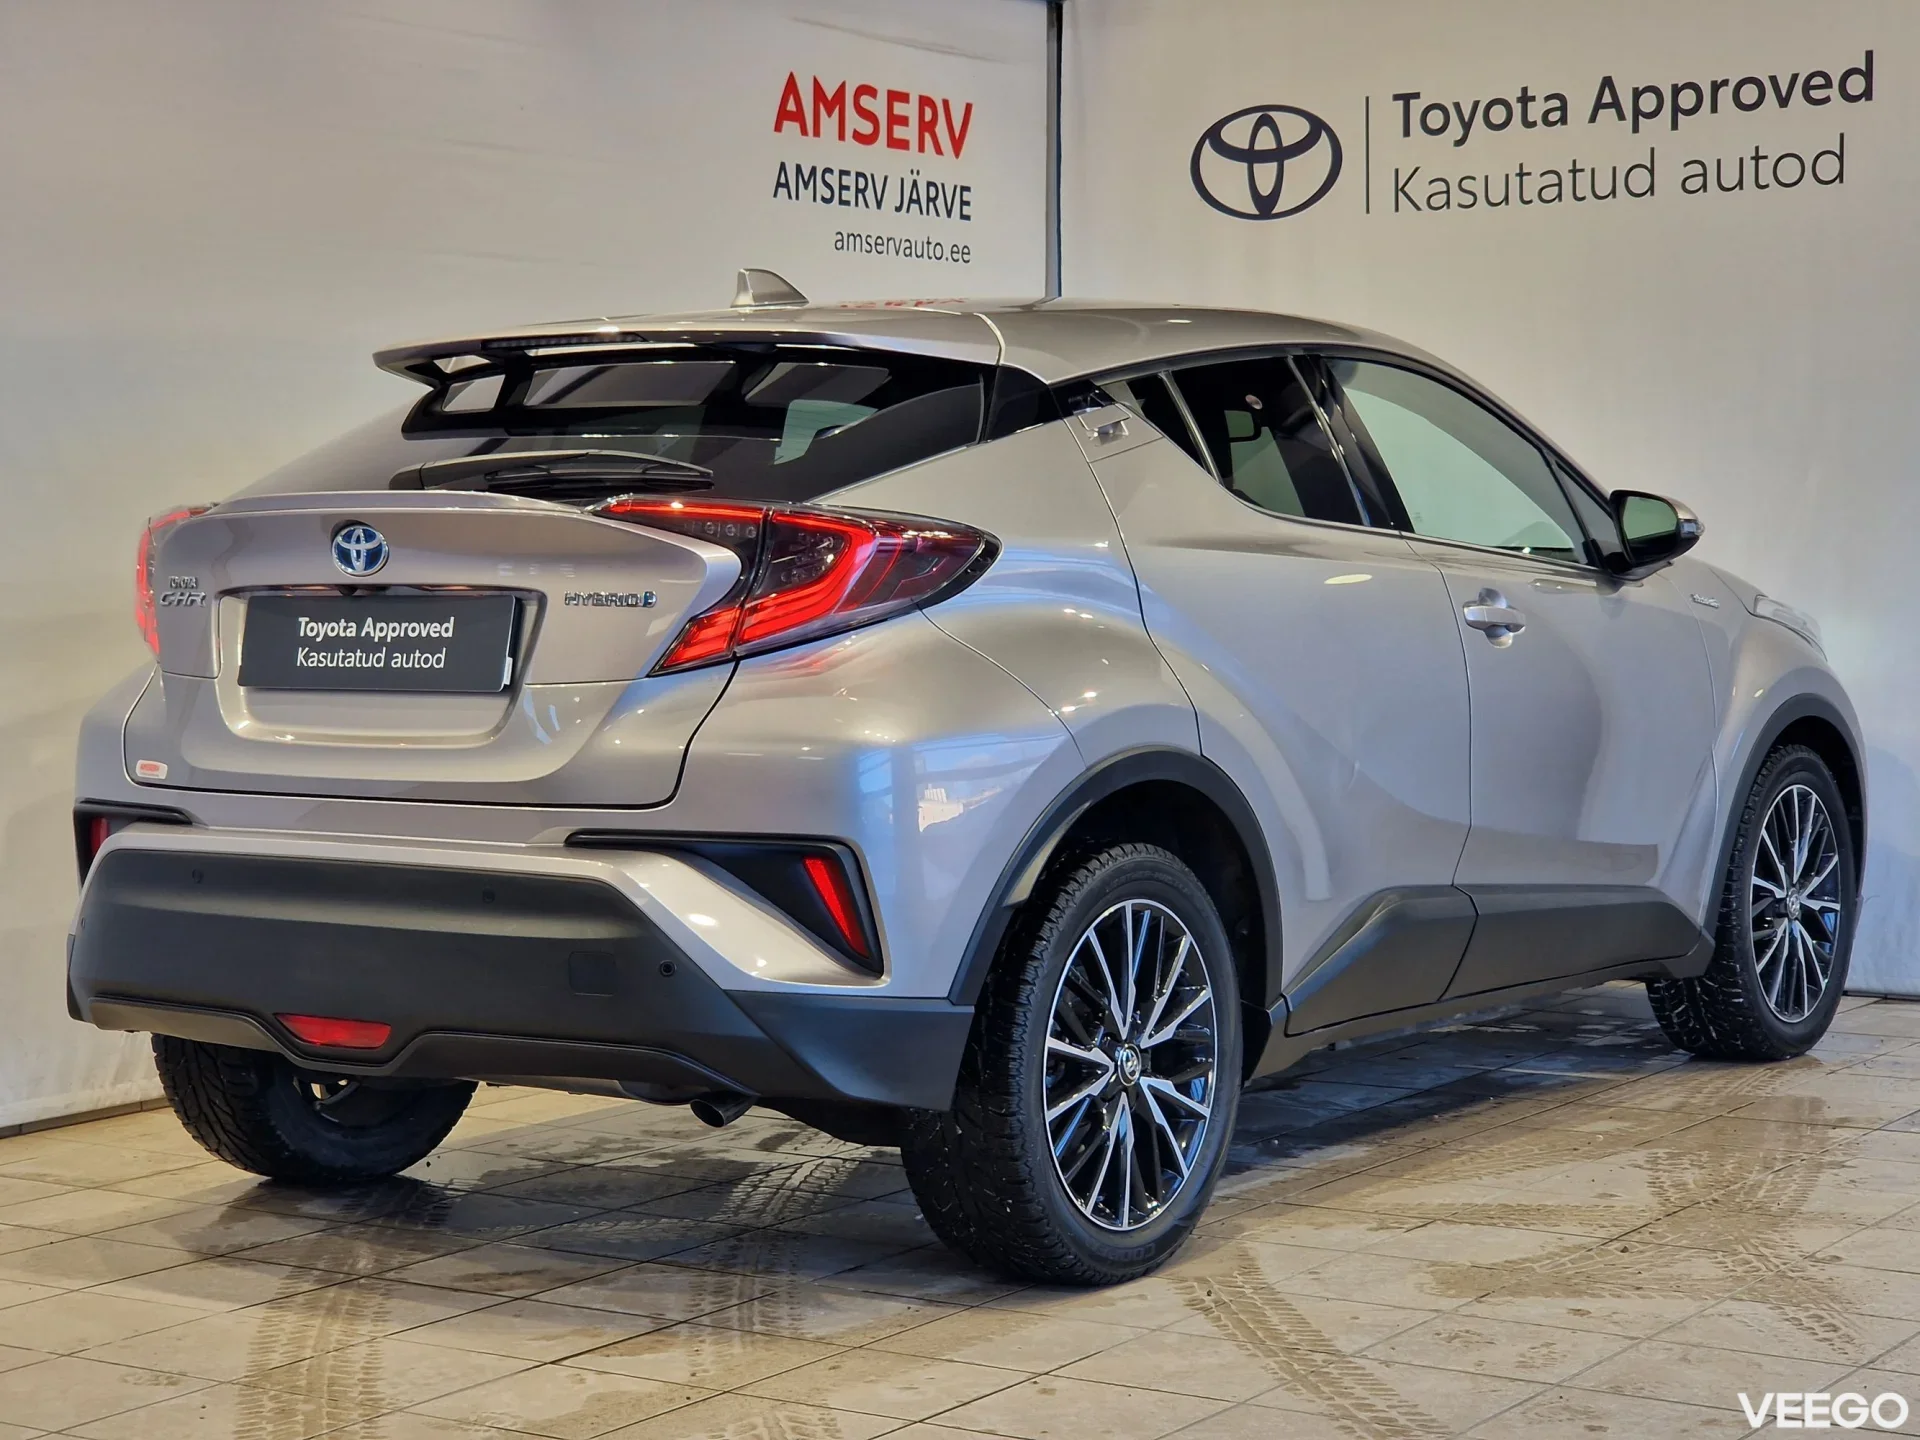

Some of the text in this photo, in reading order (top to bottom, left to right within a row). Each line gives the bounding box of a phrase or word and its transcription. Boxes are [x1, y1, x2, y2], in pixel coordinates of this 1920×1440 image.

[774, 71, 973, 160] AMSERV
[1392, 49, 1874, 147] Toyota Approved
[773, 161, 972, 222] AMSERV JÄRVE
[1394, 133, 1846, 213] Kasutatud autod
[834, 230, 971, 264] amservauto.ee
[564, 590, 639, 607] HYBRID
[298, 616, 455, 643] Toyota Approved
[296, 646, 447, 669] Kasutatud autod
